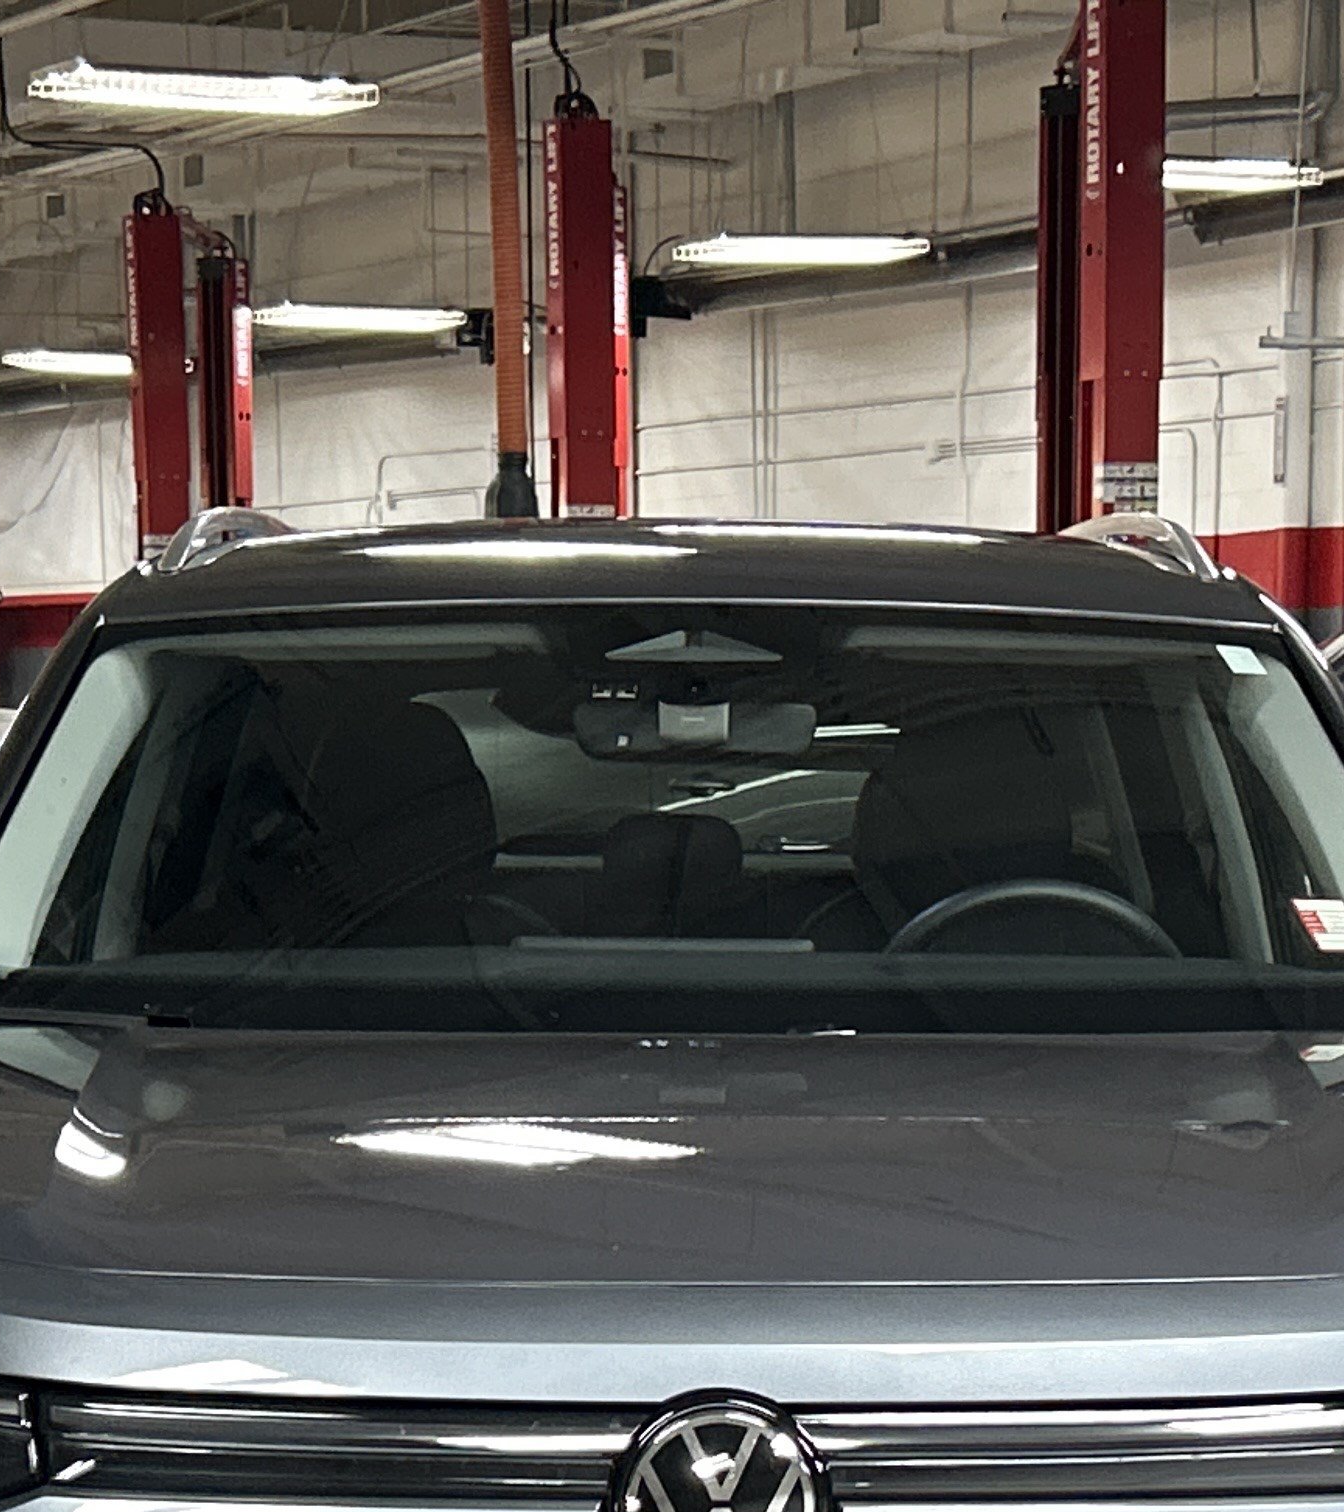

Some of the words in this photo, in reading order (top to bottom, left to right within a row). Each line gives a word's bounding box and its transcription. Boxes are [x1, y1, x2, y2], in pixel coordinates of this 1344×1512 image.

[546, 123, 557, 173] LIFT
[1086, 65, 1101, 185] ROTARY
[547, 180, 559, 276] ROTARY
